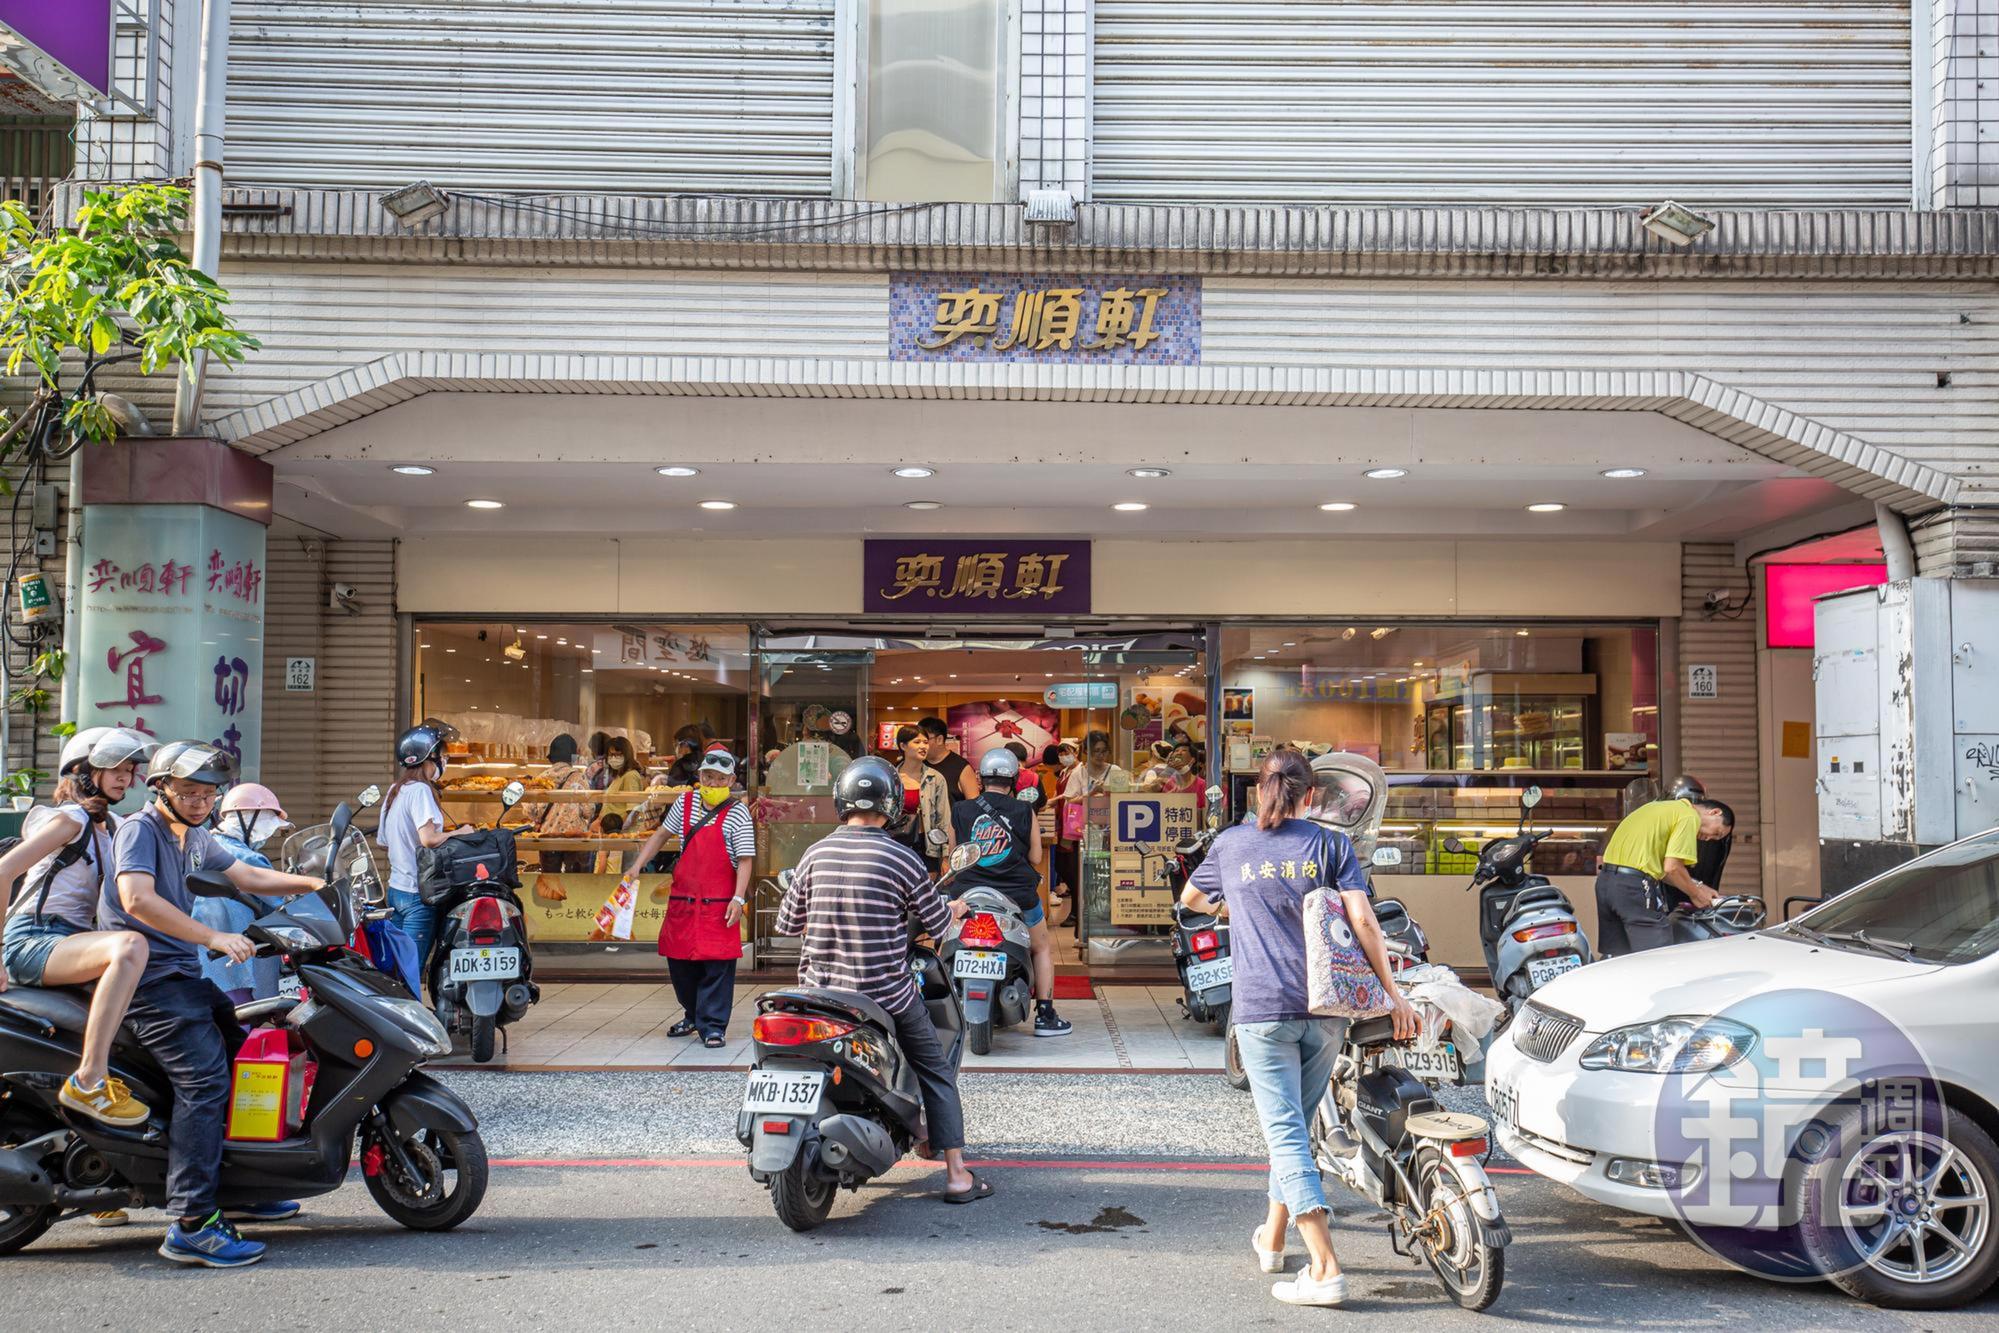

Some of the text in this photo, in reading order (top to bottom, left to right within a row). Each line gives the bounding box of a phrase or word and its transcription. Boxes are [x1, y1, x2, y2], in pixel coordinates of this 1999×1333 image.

[914, 287, 1169, 350] 奕順軒
[88, 558, 194, 595] 奕順軒
[208, 549, 261, 604] 奕順軒
[880, 553, 1069, 600] 奕順軒
[291, 674, 309, 685] 162
[1694, 681, 1712, 691] 160
[1127, 804, 1154, 839] P
[1164, 807, 1193, 823] 特約
[1165, 826, 1193, 842] 停車
[1241, 860, 1317, 882] 民安消防
[454, 957, 517, 973] ADK-3159
[956, 960, 1004, 975] 072-HXA
[1404, 1052, 1457, 1073] CZ9-315
[747, 1081, 820, 1104] MKB-1337
[1357, 1100, 1383, 1116] GIANT
